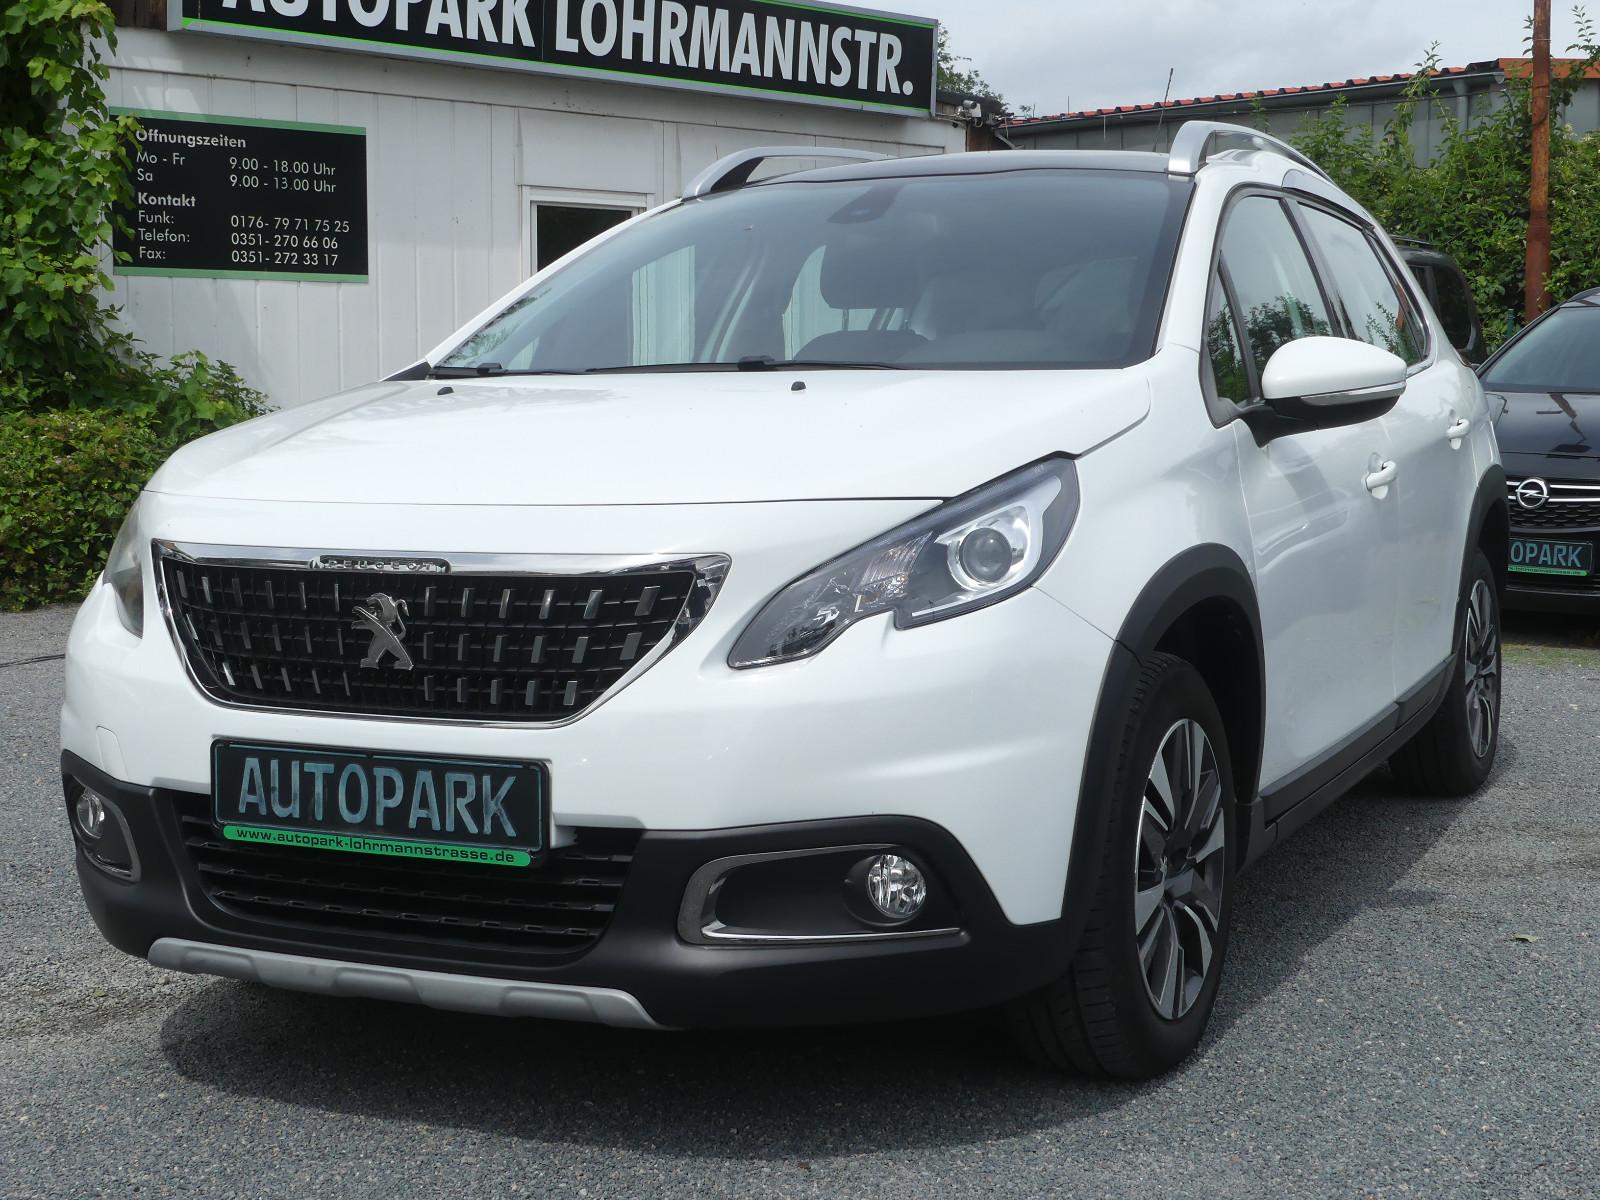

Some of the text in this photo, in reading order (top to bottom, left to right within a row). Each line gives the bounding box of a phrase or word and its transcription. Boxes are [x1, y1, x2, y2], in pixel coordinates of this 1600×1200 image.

[555, 0, 914, 96] LOHRMANNSTR.
[135, 126, 246, 148] Öffnungszeiten
[136, 151, 158, 163] Mo
[172, 153, 186, 166] Fr
[229, 157, 259, 171] 9.00
[274, 160, 309, 174] 18.00
[313, 162, 336, 176] Uhr
[136, 168, 153, 182] Sa
[230, 174, 259, 188] 9.00
[274, 178, 309, 191] 13.00
[314, 179, 337, 193] Uhr
[137, 191, 196, 208] Kontakt
[138, 210, 350, 233] Funk: 0176- 79 71 75 25
[138, 228, 338, 249] Telefon: 0351- 270 66 06
[139, 247, 338, 266] Fax: 0351- 272 33 17
[238, 757, 517, 838] AUTOPARK
[236, 828, 515, 863] www.autopark-lohrmannstrasse.de
